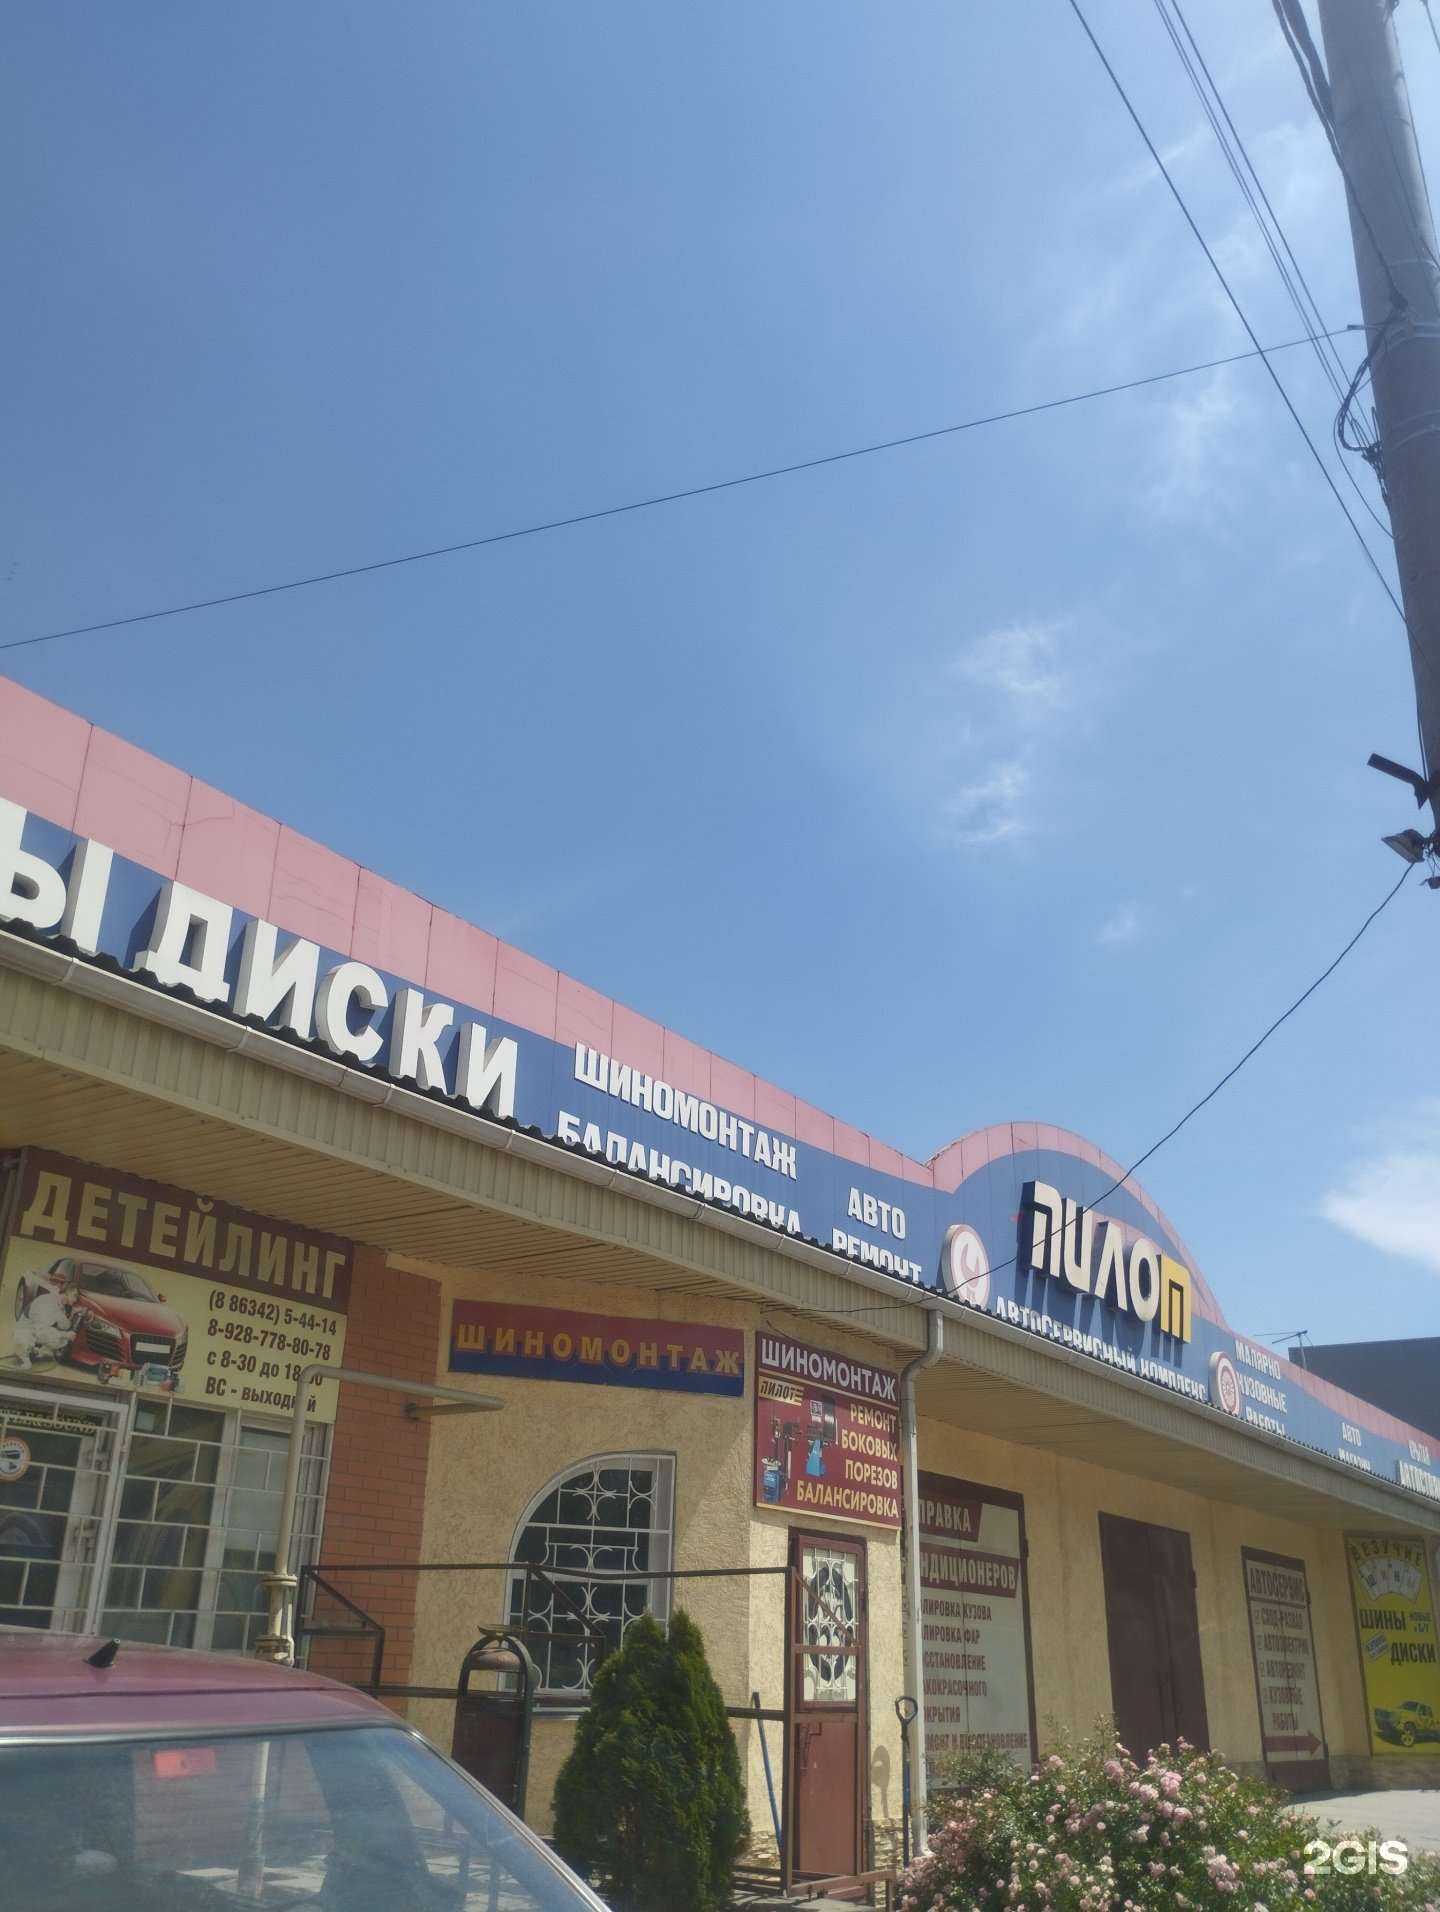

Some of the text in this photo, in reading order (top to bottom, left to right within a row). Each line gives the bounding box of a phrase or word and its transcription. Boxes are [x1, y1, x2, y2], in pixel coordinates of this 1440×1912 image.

[131, 880, 517, 1119] ДИСКИ
[575, 1041, 797, 1181] ШИНОМОНТАЖ
[848, 1187, 906, 1240] АВТО
[20, 1171, 346, 1299] ДЕТЕЙЛИНГ
[229, 1295, 280, 1325] 86342)
[284, 1308, 337, 1335] 5-44-14
[207, 1318, 331, 1360] 8-928-778-80-78
[457, 1323, 740, 1375] ШИНОМОНТАЖ
[221, 1351, 256, 1372] 8-30
[260, 1362, 279, 1378] до
[761, 1338, 896, 1401] ШИНОМОНТАЖ
[205, 1376, 227, 1396] ВС
[760, 1380, 796, 1400] ПИЛОТ
[850, 1403, 896, 1433] РЕМОНТ
[841, 1429, 898, 1461] БОКОВЫХ
[845, 1459, 898, 1489] ПОРЕЗОВ
[797, 1480, 899, 1518] БАЛАНСИРОВКА
[918, 1501, 971, 1532] ПРАВКА
[920, 1552, 1016, 1590] НДИЦИОНЕРОВ
[921, 1599, 961, 1618] ЛИРОВКА
[1360, 1609, 1406, 1631] ШИНЫ
[922, 1624, 961, 1643] ЛИРОВКА
[922, 1651, 987, 1671] ССТАНОВЛЕНИЕ
[1391, 1641, 1437, 1666] ДИСКИ
[923, 1680, 987, 1698] КОКРАСОЧНОГО
[923, 1705, 961, 1723] КРЫТИЯ
